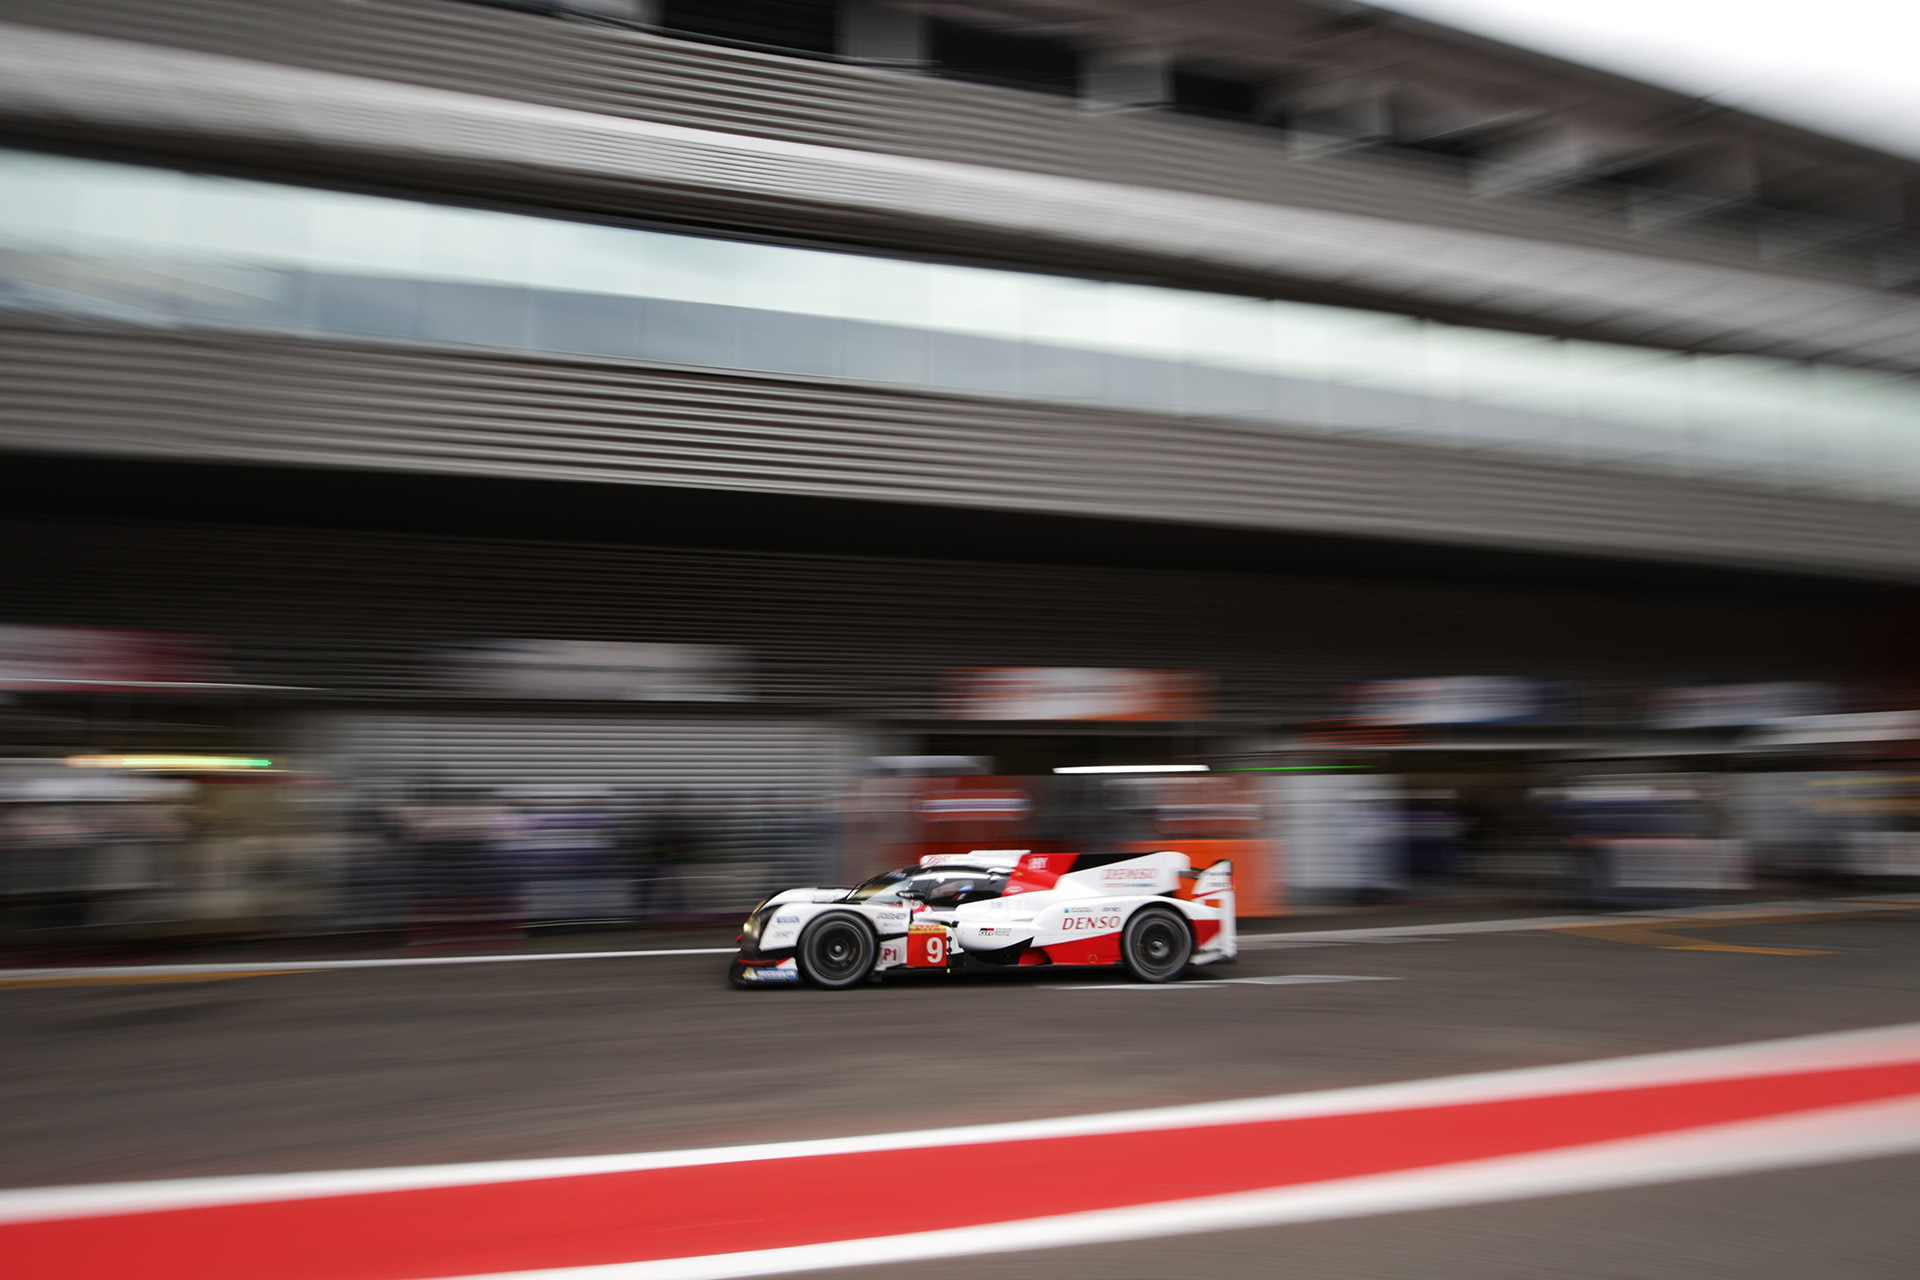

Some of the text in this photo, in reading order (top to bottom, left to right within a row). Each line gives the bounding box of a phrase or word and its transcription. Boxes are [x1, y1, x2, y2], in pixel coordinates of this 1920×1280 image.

[1062, 916, 1121, 930] DENSO
[884, 948, 897, 961] P1
[926, 937, 943, 963] 9
